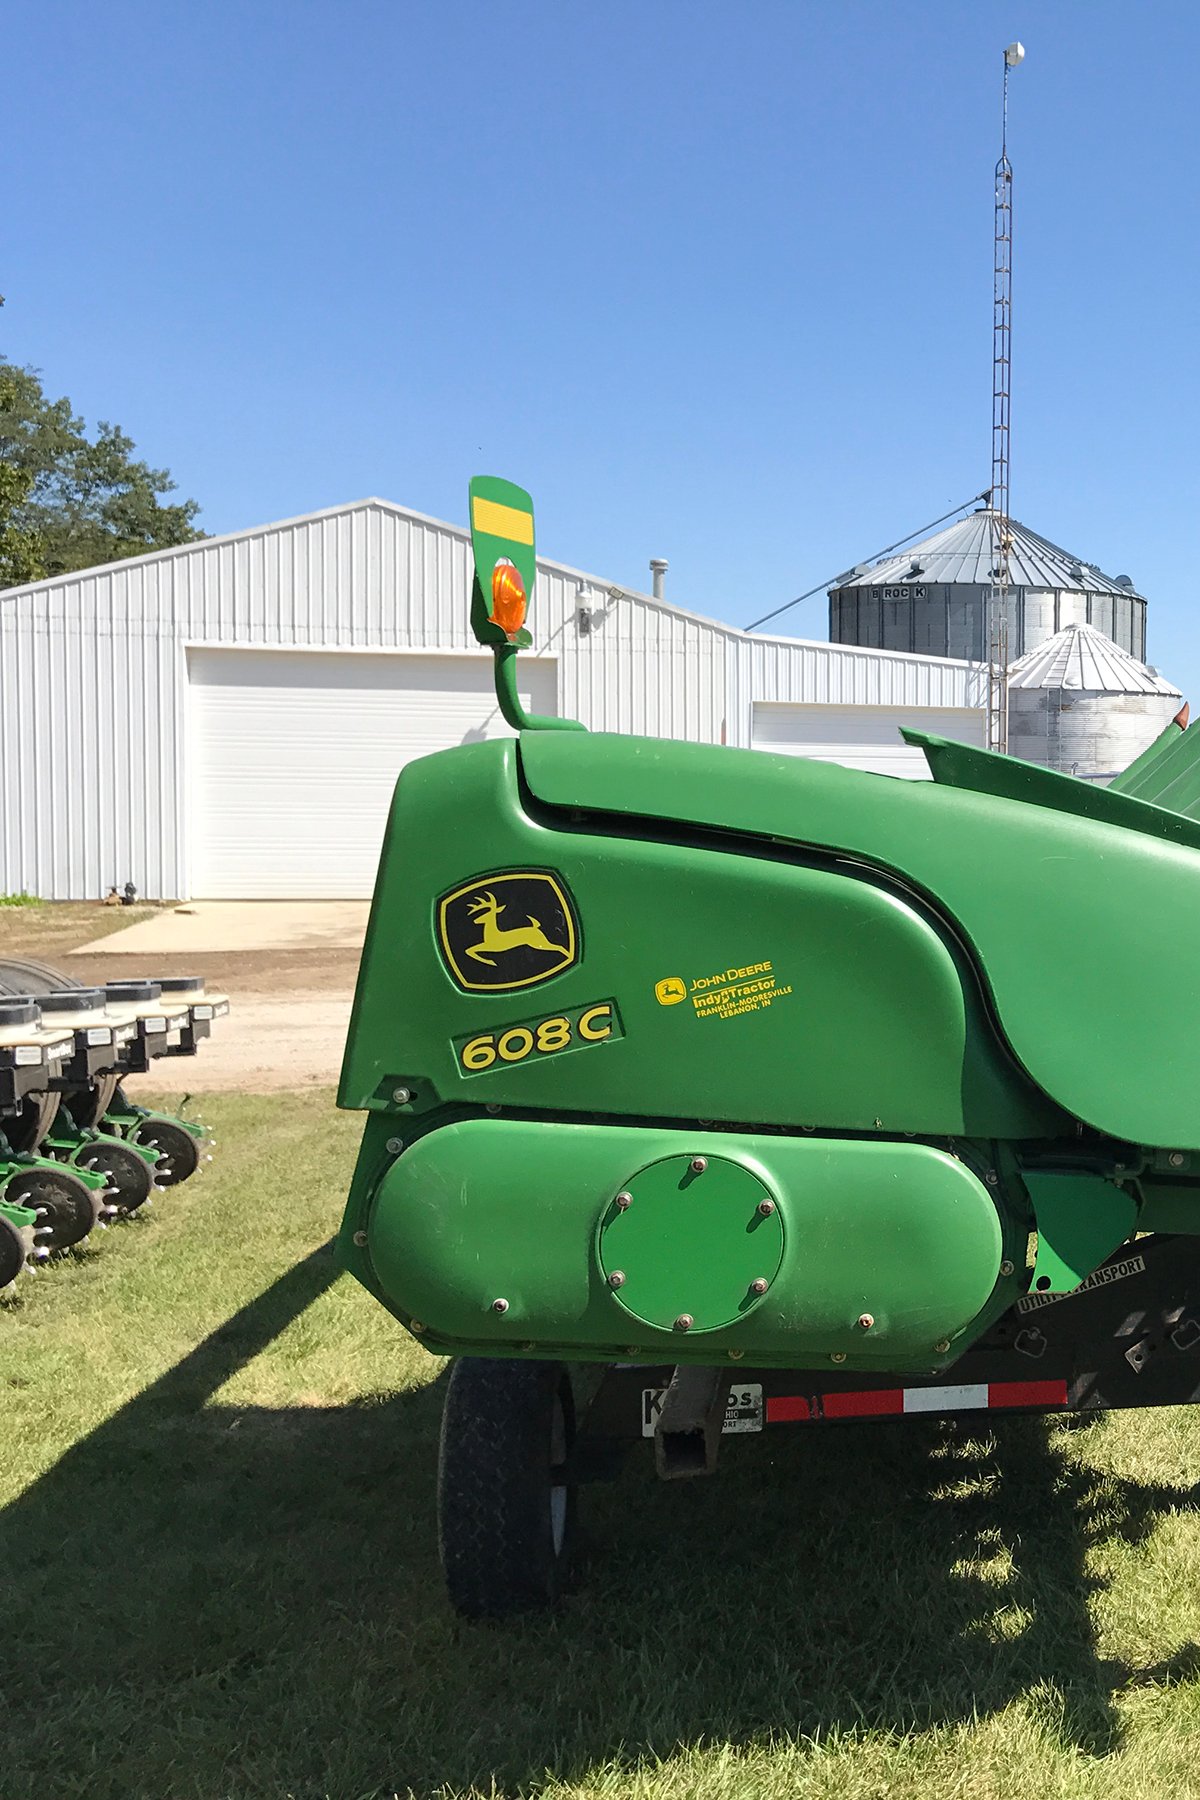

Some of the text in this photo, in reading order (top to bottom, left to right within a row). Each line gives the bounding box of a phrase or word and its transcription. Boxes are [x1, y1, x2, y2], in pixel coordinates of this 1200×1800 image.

[872, 588, 924, 599] BROCK
[690, 961, 772, 992] JOHN DEERE
[762, 999, 771, 1007] IN
[725, 1409, 739, 1420] HIO
